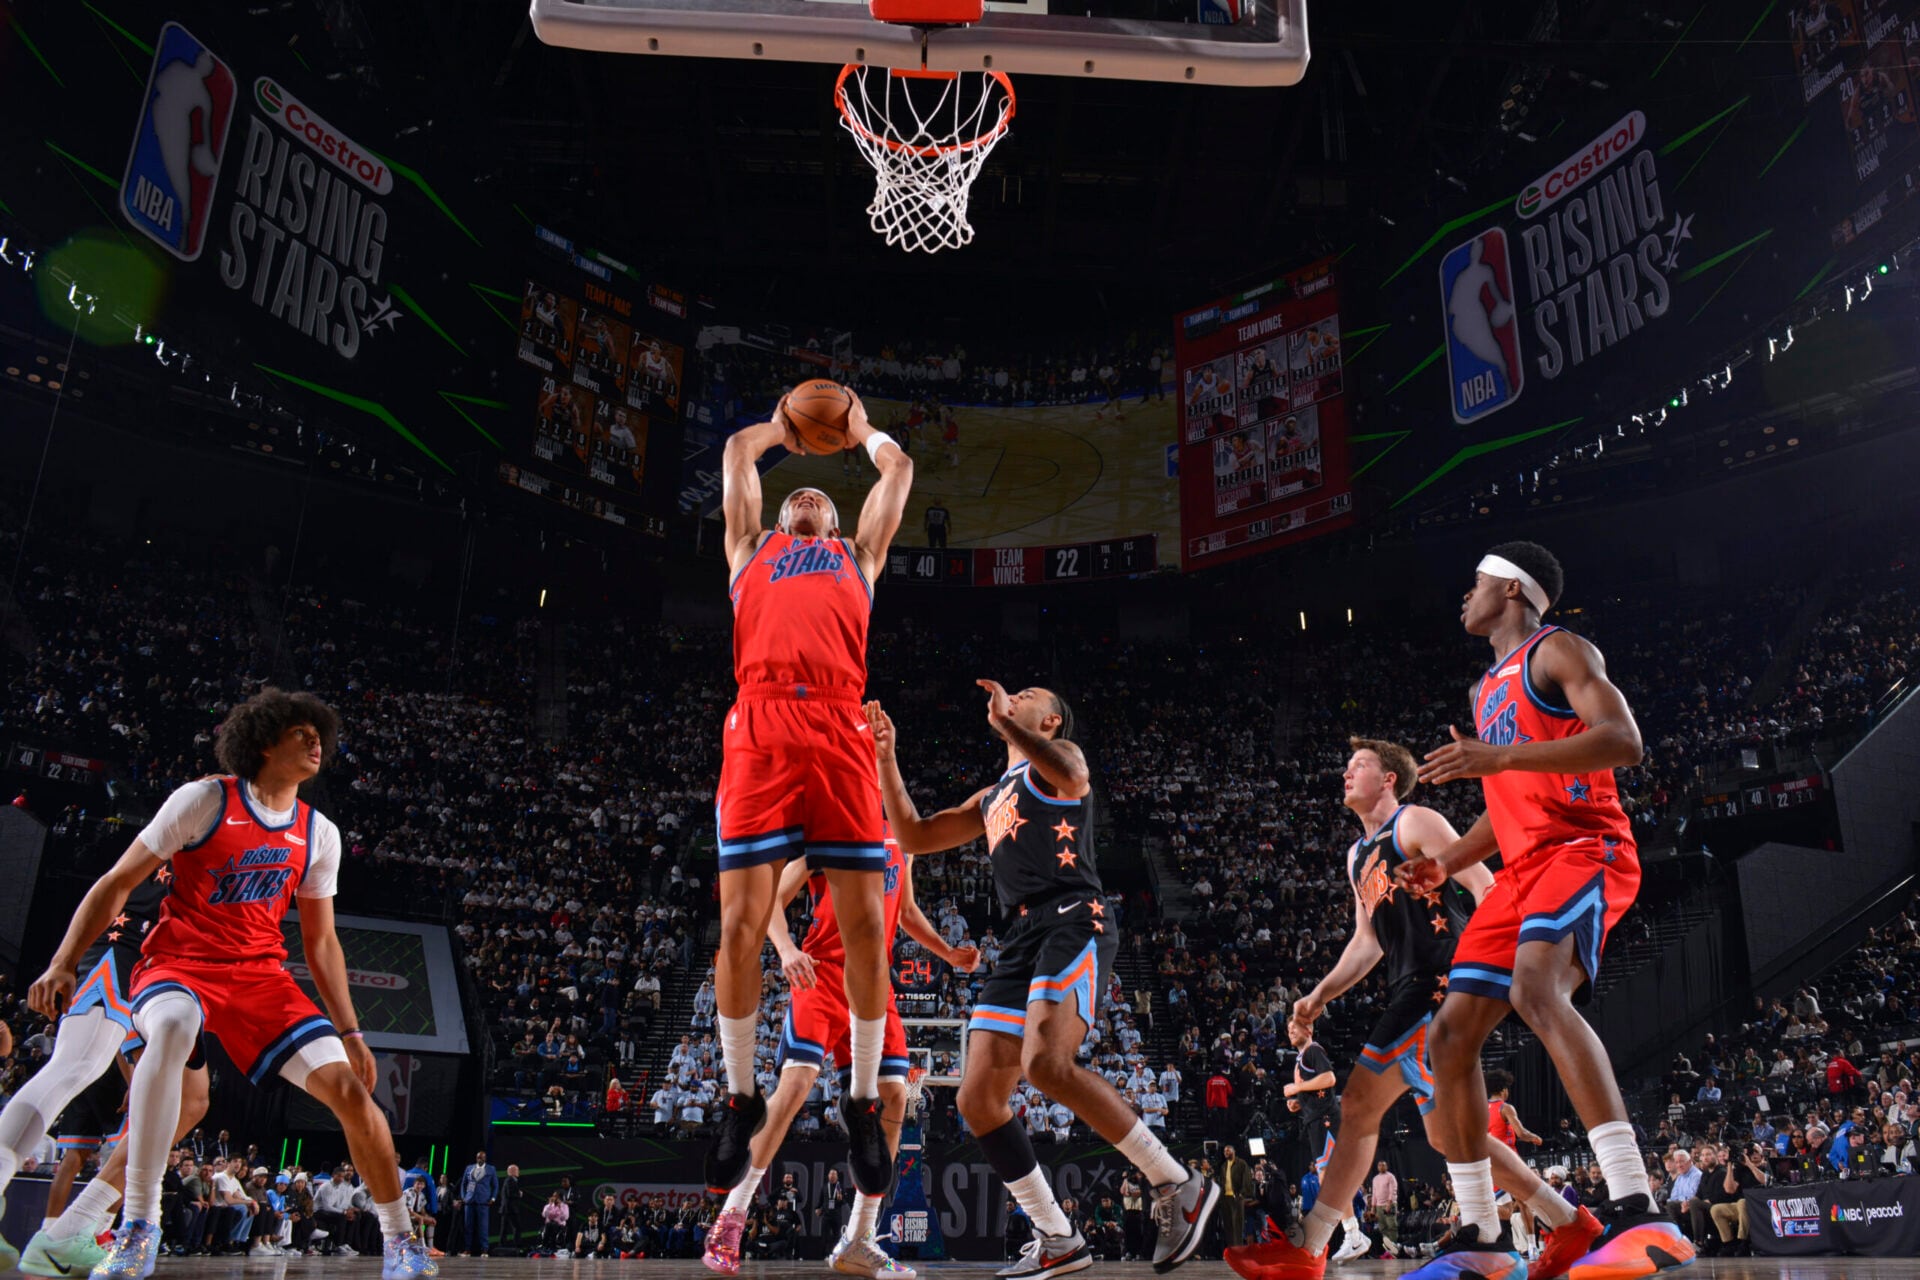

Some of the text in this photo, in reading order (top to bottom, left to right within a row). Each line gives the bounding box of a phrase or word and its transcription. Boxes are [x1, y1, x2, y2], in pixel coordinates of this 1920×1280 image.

[1204, 10, 1225, 24] NBA
[1904, 20, 1919, 48] 24
[1840, 77, 1855, 102] 20
[284, 103, 384, 187] Castrol
[1545, 117, 1635, 199] Castrol
[132, 175, 174, 231] NBA
[236, 114, 388, 285] RISING
[1521, 149, 1664, 301] RISING
[220, 202, 367, 360] STARS
[1534, 233, 1670, 380] STARS
[1238, 313, 1284, 342] TEAM VINCE
[1289, 332, 1299, 349] 11
[542, 376, 556, 394] 20
[1460, 369, 1497, 410] NBA
[597, 400, 609, 417] 24
[1267, 420, 1278, 436] 77
[769, 546, 844, 583] STARS
[916, 554, 934, 577] 40
[995, 548, 1023, 567] TEAM
[1056, 549, 1079, 577] 22
[1103, 558, 1109, 570] 2
[993, 567, 1025, 585] VINCE
[20, 751, 34, 766] 40
[48, 762, 62, 779] 22
[1726, 801, 1737, 816] 24
[1751, 791, 1761, 805] 40
[1777, 792, 1789, 807] 22
[237, 847, 292, 867] RISING
[208, 868, 293, 904] STARS
[289, 965, 396, 987] Ctrol
[900, 960, 931, 984] 24
[904, 1218, 928, 1230] RISING
[1843, 1201, 1903, 1225] NBC peacock
[904, 1230, 927, 1242] STARS
